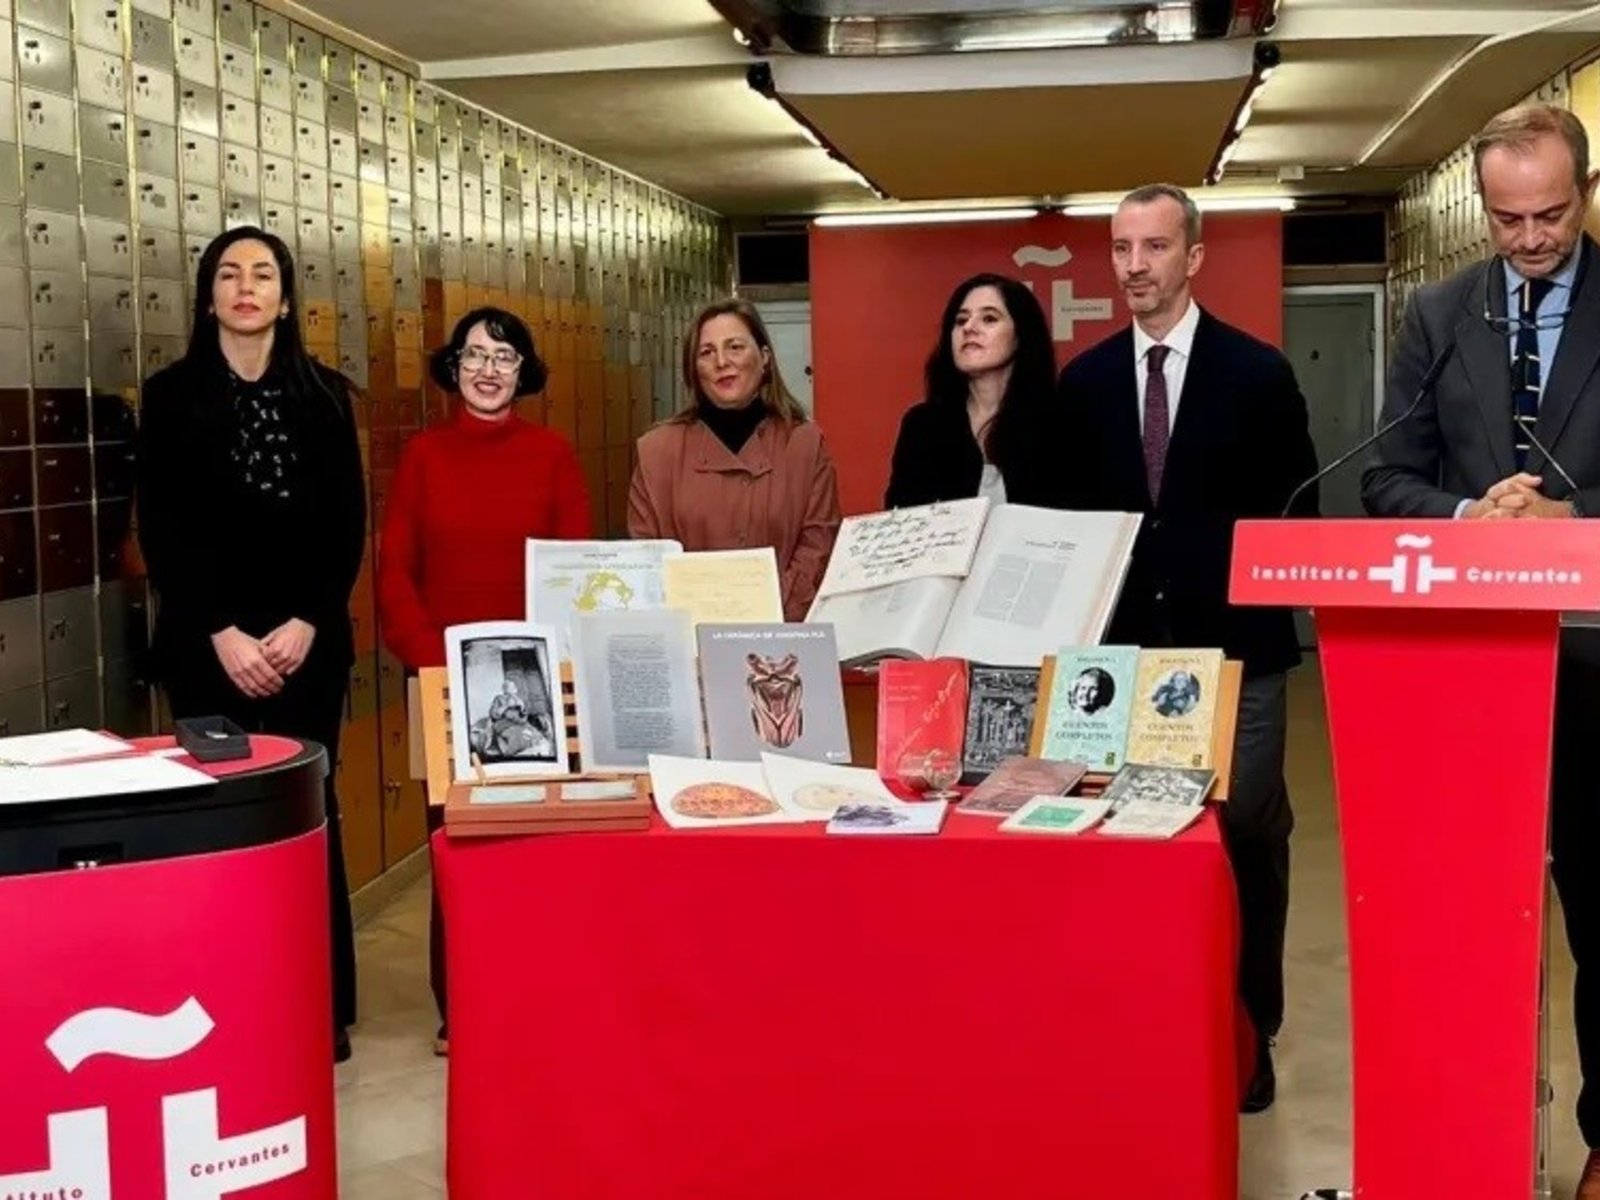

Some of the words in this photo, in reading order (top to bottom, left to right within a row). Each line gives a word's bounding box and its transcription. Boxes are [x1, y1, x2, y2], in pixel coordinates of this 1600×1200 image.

[1252, 565, 1358, 581] Instituto
[1466, 566, 1582, 583] Cervantes
[1062, 721, 1108, 729] CUENTOS
[1147, 722, 1193, 731] CUENTOS
[1055, 731, 1112, 740] COMPLETOS
[1139, 733, 1197, 742] COMPLETOS
[190, 1142, 290, 1177] Cervantes
